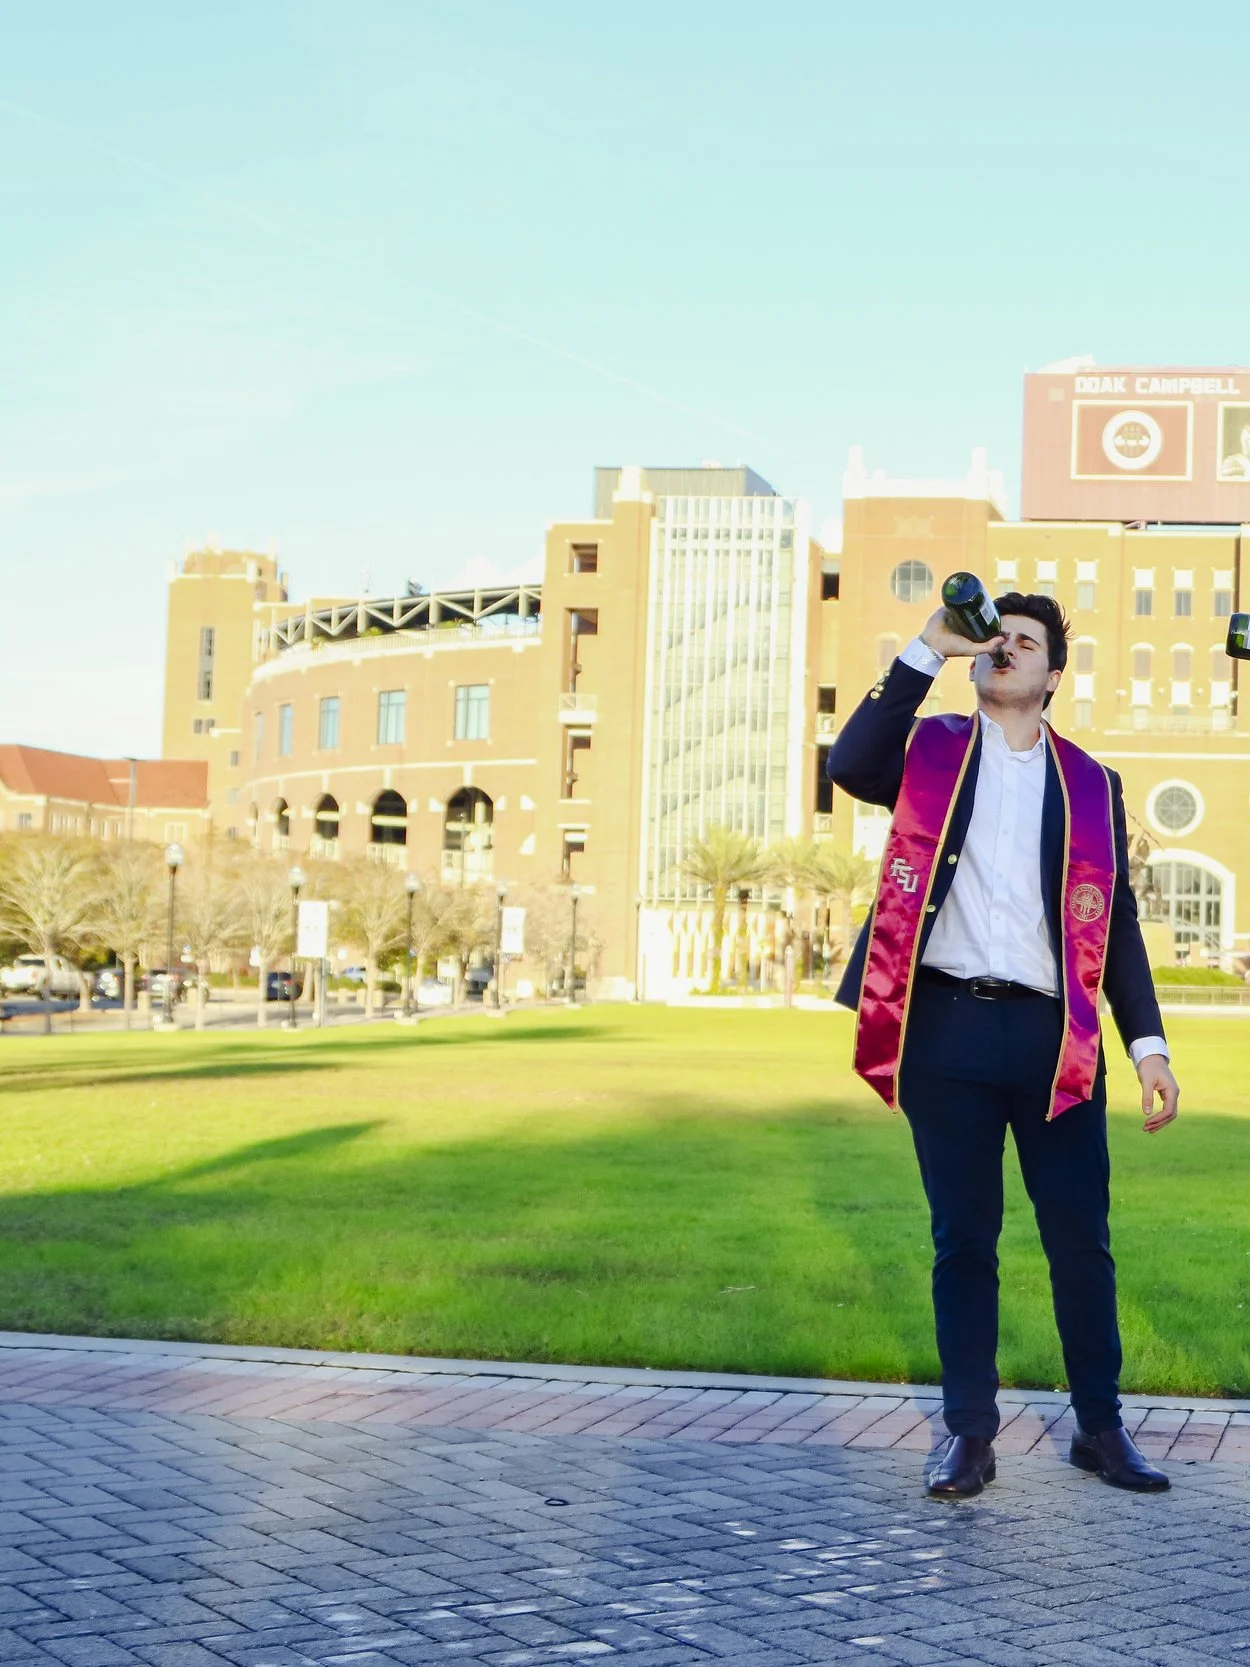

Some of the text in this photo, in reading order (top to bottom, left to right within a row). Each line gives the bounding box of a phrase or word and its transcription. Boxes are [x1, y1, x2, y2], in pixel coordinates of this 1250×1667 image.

[1074, 376, 1127, 394] DOAK
[1135, 377, 1241, 395] CAMPBELL
[889, 858, 919, 893] FSU
